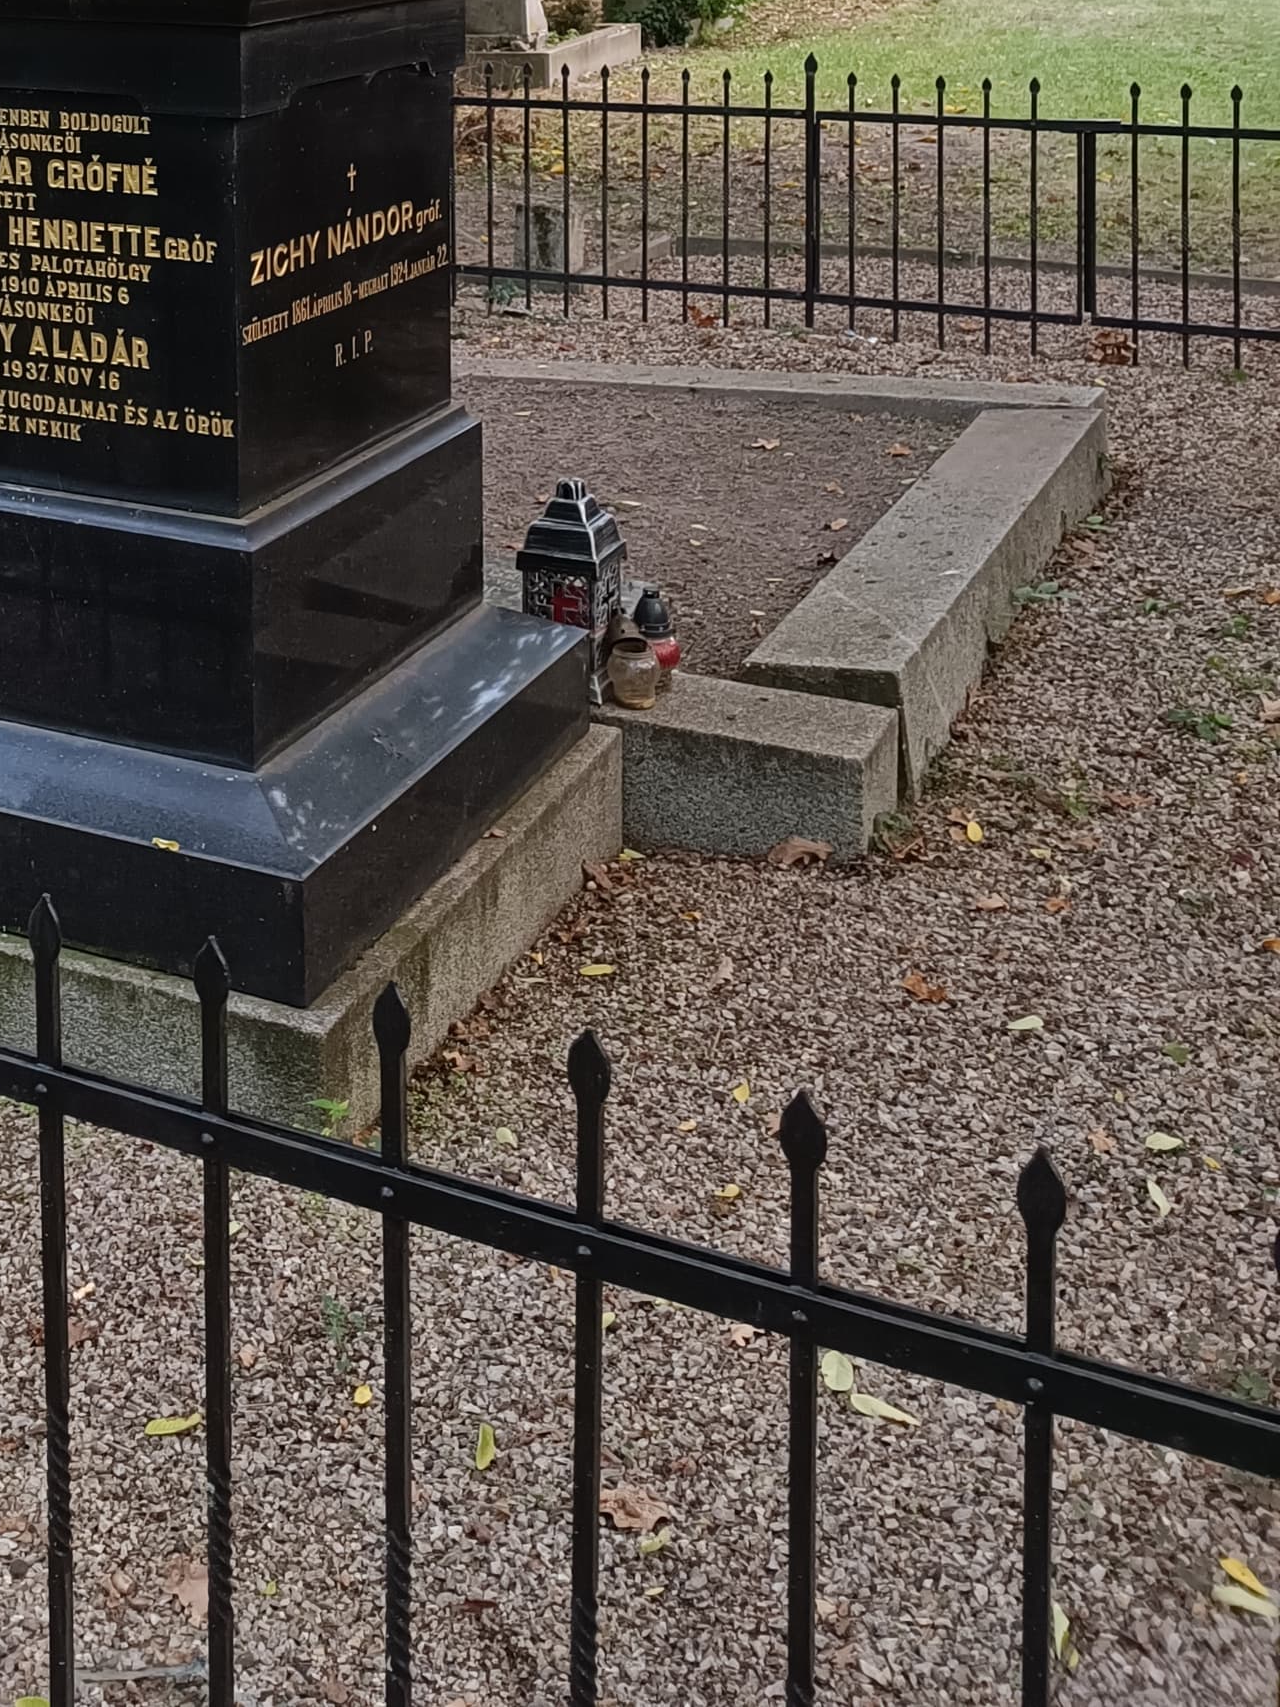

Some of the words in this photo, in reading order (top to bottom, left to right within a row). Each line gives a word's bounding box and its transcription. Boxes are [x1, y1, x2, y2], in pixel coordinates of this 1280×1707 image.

[59, 111, 151, 135] BOLDOGULT
[47, 154, 159, 196] GRÓFNÉ
[8, 214, 161, 258] HENRIETTE
[164, 233, 218, 263] GRÓF
[250, 230, 320, 287] ZICHY
[327, 200, 414, 259] NÁNDOR
[416, 198, 443, 233] gróf.
[30, 254, 152, 283] PALOTAHÖLGY
[117, 286, 130, 305] 6
[241, 310, 290, 345] SZÜLETETT
[28, 325, 151, 370] ALADÁR
[54, 364, 94, 386] NOV
[99, 369, 121, 391] 16
[25, 416, 82, 442] NEKIK
[124, 398, 148, 426] ÉS
[153, 409, 180, 431] AZ
[184, 406, 235, 438] ÖRÖK
